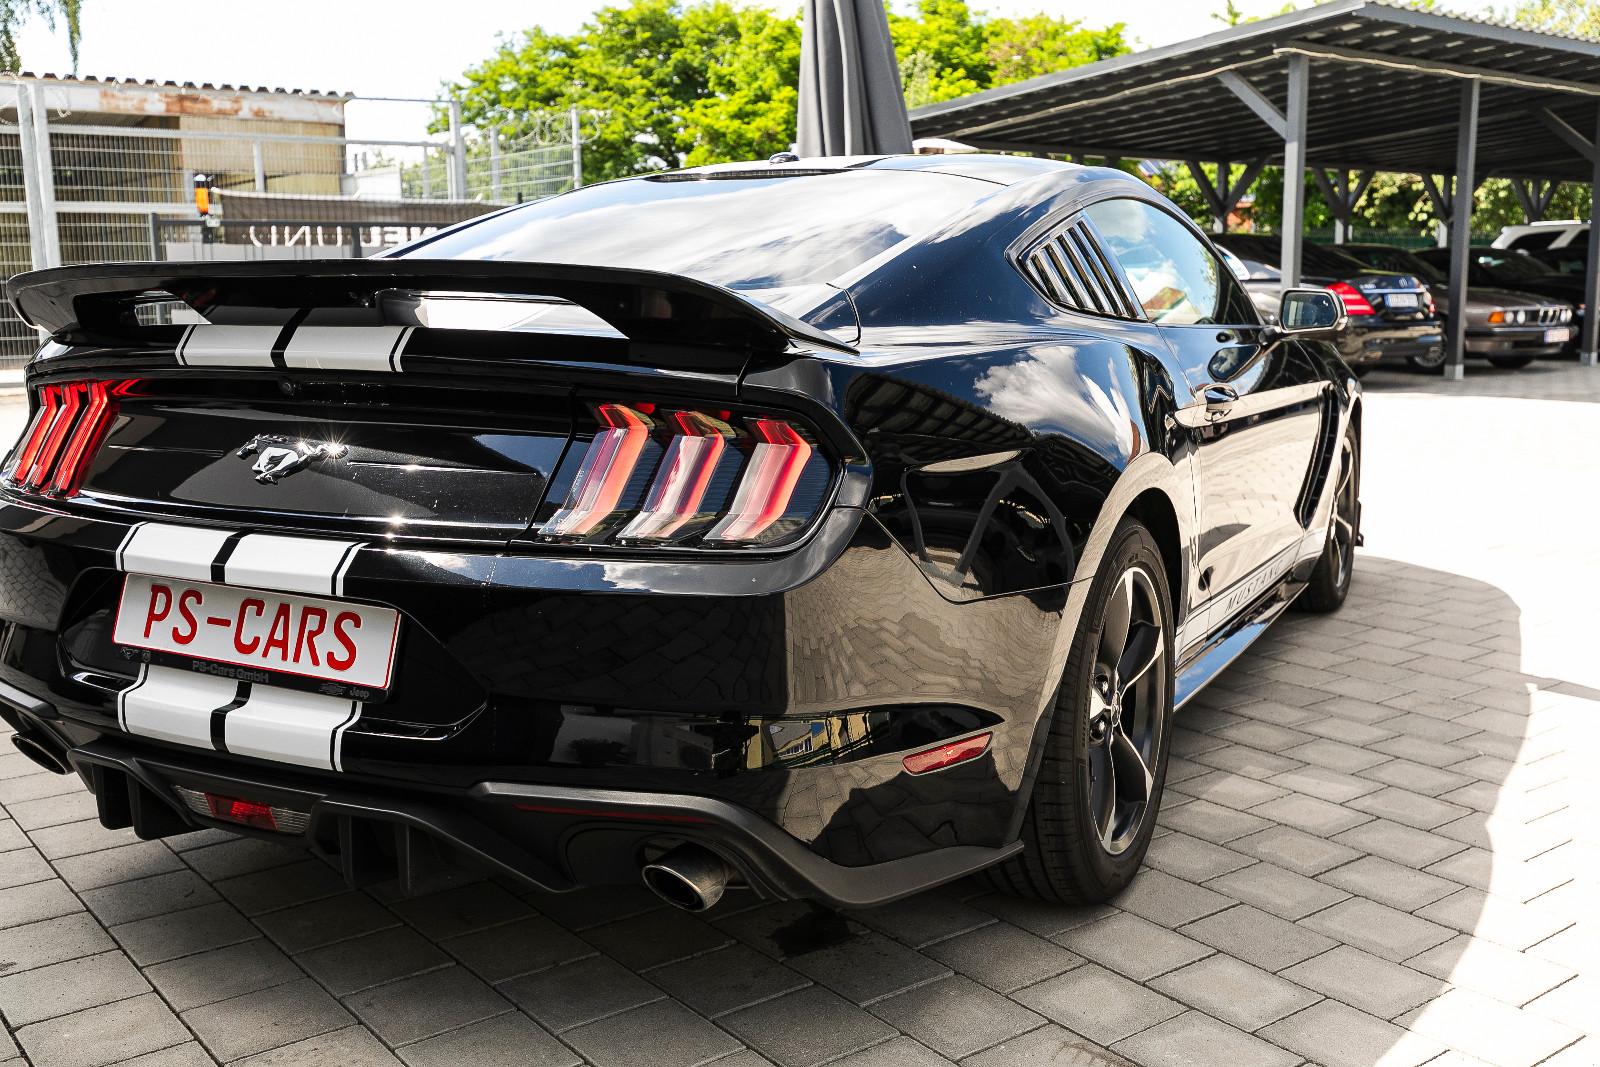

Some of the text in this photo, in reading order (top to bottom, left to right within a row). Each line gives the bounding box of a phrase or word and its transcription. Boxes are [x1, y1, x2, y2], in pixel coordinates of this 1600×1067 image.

[1225, 560, 1284, 613] MUSTANG
[143, 585, 362, 671] PS-CARS
[192, 660, 269, 684] PS-Cars GmbH
[349, 686, 369, 700] Jeep
